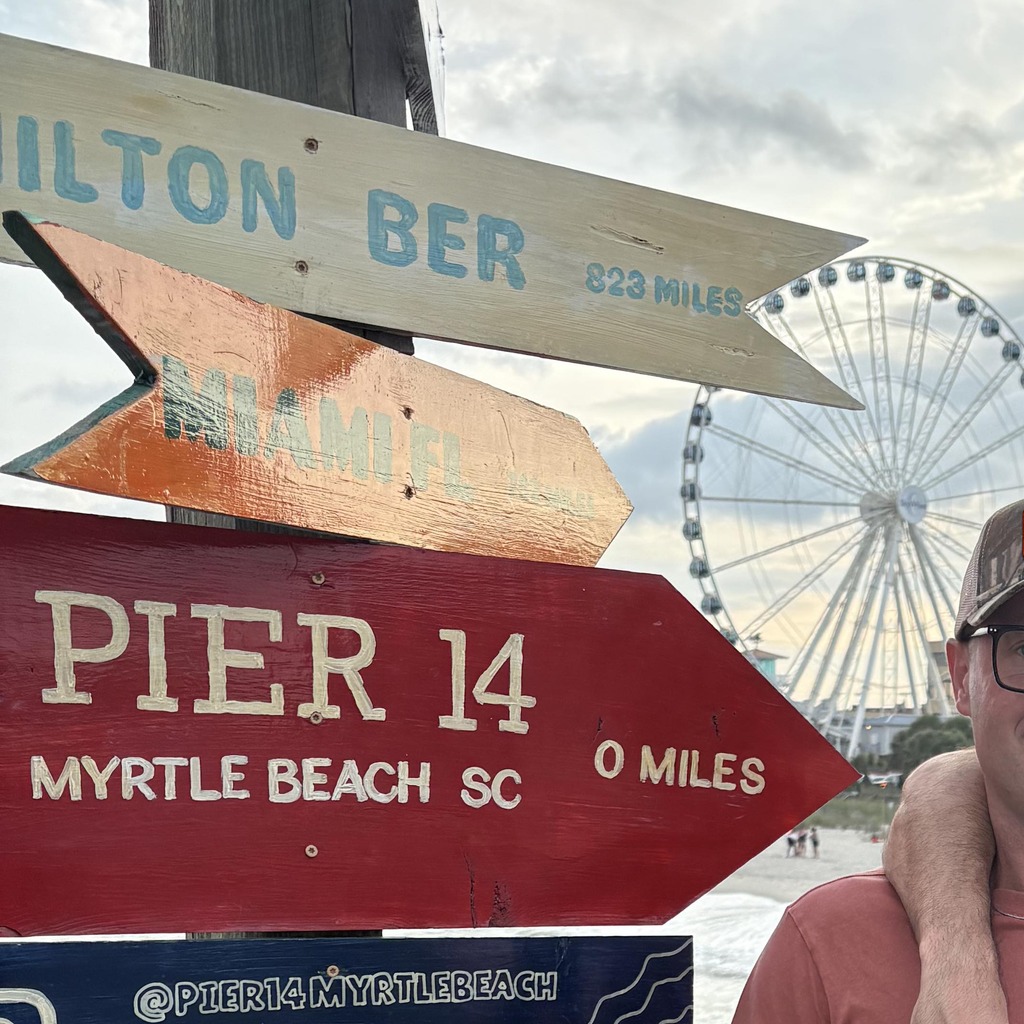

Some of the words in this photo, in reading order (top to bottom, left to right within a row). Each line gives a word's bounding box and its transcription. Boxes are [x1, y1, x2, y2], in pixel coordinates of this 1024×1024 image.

[0, 113, 296, 240] ILTON
[367, 188, 526, 290] BER
[586, 263, 646, 296] 823
[654, 274, 743, 318] MILES
[161, 355, 393, 485] MIAMI
[410, 422, 474, 502] FL
[34, 589, 387, 722] PIER
[438, 628, 538, 735] 14
[30, 754, 251, 802] MYRTLE
[267, 756, 431, 805] BEACH
[460, 766, 523, 811] SC
[594, 739, 625, 780] 0
[639, 746, 766, 796] MILES
